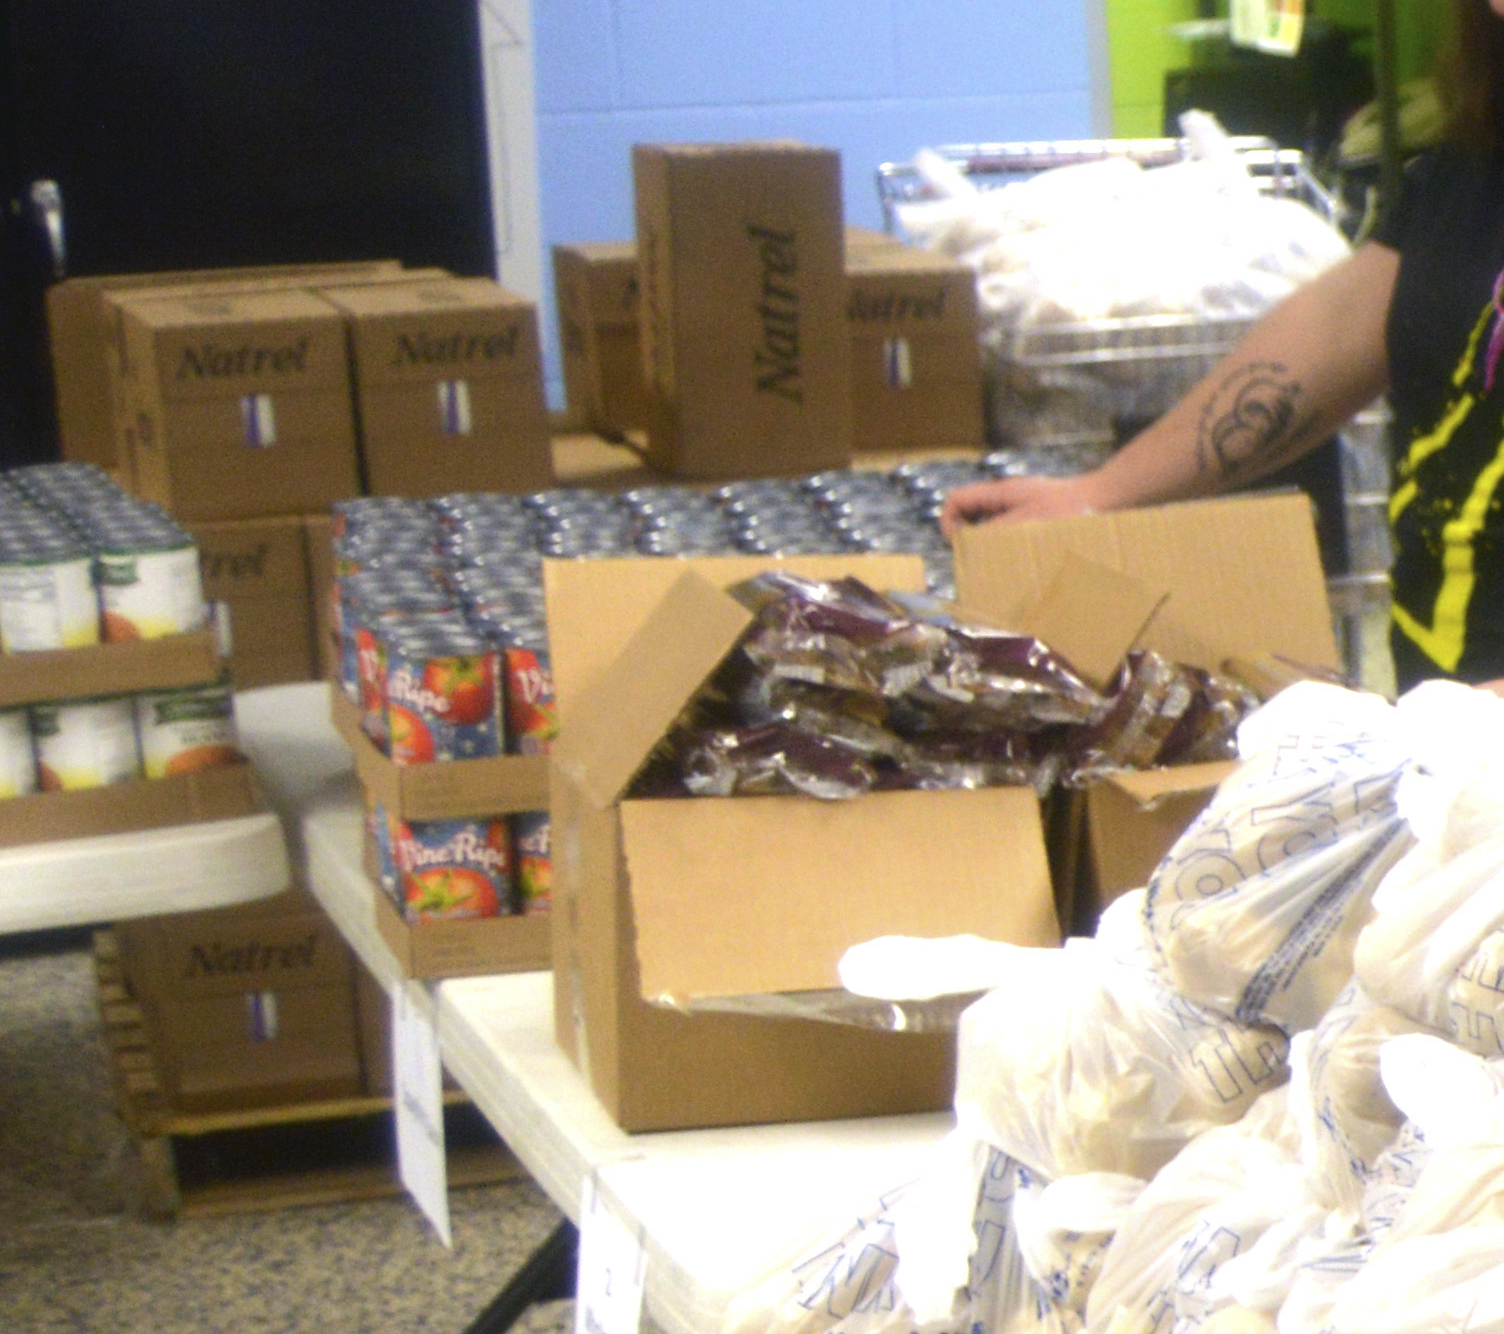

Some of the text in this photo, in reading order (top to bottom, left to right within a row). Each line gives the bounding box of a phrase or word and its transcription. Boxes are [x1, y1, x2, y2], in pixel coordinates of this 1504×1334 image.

[747, 223, 802, 405] Natrel
[176, 338, 308, 378] Natrel
[396, 325, 518, 365] Natrel
[388, 668, 449, 713] Ripe
